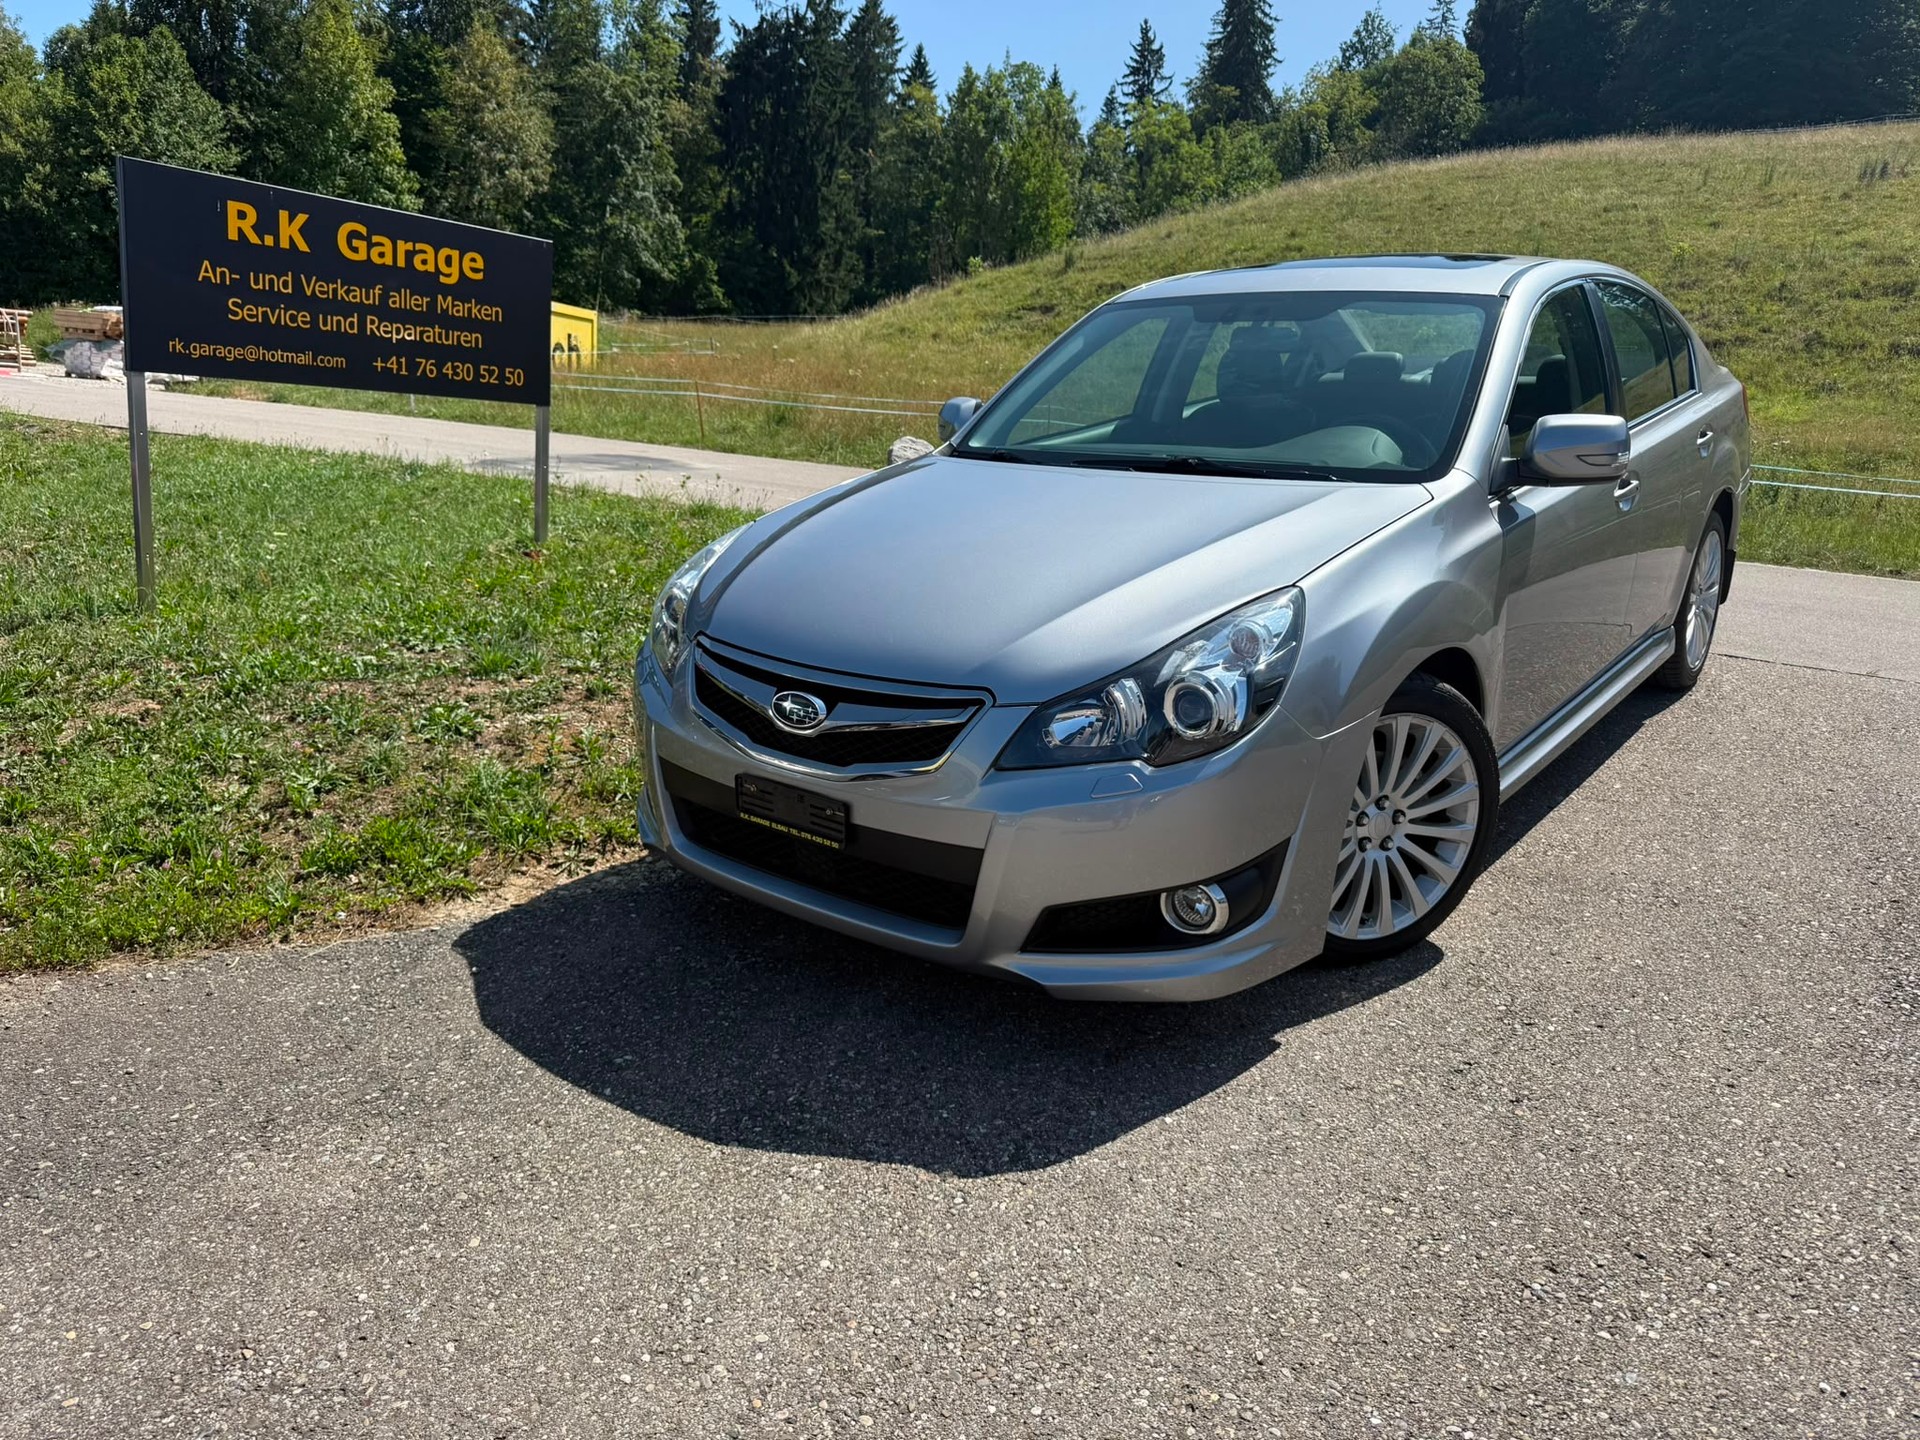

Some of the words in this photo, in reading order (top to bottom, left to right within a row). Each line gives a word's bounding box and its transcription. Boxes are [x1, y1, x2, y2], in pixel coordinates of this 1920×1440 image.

[227, 200, 311, 253] R.K
[337, 221, 485, 285] Garage
[198, 260, 240, 285] An-
[250, 271, 293, 294] und
[301, 274, 383, 306] Verkauf
[388, 290, 430, 312] aller
[437, 295, 503, 322] Marken
[227, 298, 311, 329] Service
[319, 314, 359, 335] und
[367, 315, 482, 348] Reparaturen
[169, 339, 346, 369] rk.garage@hotmail.com
[373, 356, 408, 375] +41
[416, 358, 437, 379] 76
[443, 362, 474, 382] 430
[480, 365, 499, 384] 52
[505, 367, 524, 386] 50
